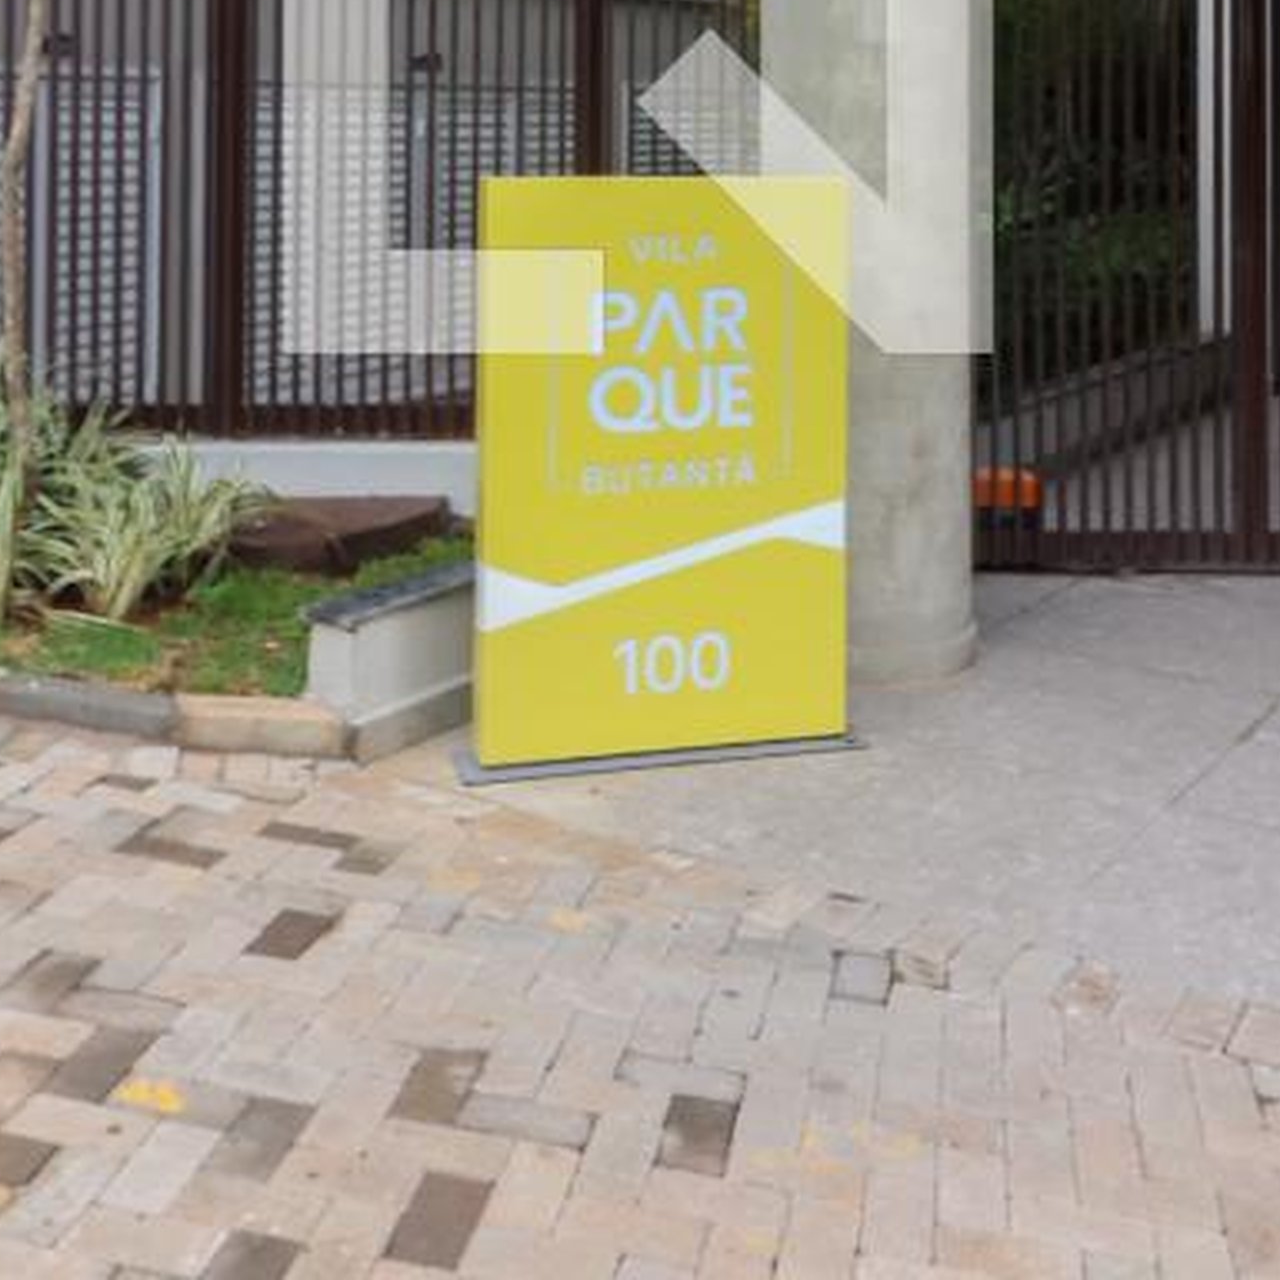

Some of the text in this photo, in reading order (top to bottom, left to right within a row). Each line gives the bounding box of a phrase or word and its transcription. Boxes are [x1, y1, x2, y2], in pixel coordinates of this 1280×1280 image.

[629, 231, 717, 264] VILA
[589, 286, 748, 356] PAR
[589, 365, 753, 433] QUE
[612, 630, 731, 694] 100
